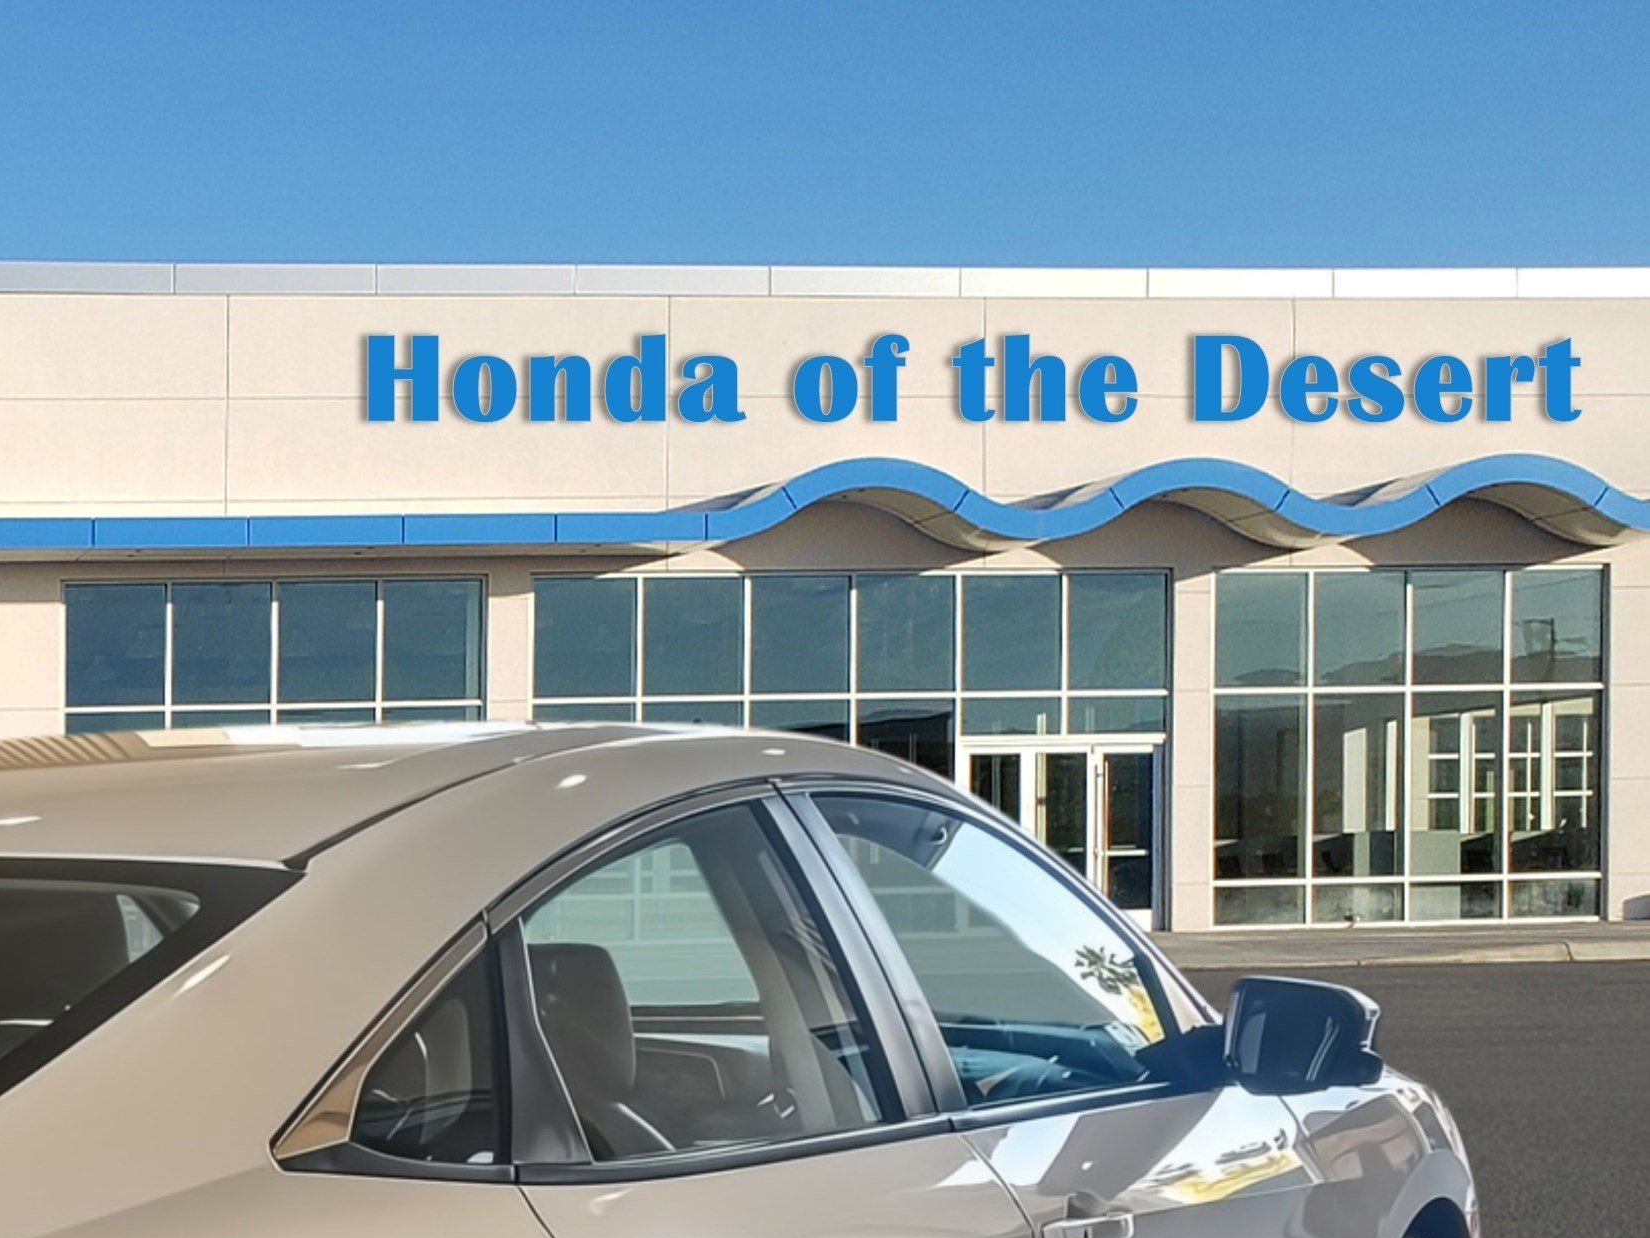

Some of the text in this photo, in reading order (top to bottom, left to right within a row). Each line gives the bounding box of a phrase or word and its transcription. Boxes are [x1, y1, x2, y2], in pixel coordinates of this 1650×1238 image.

[366, 333, 1583, 424] Honda of the Desert
